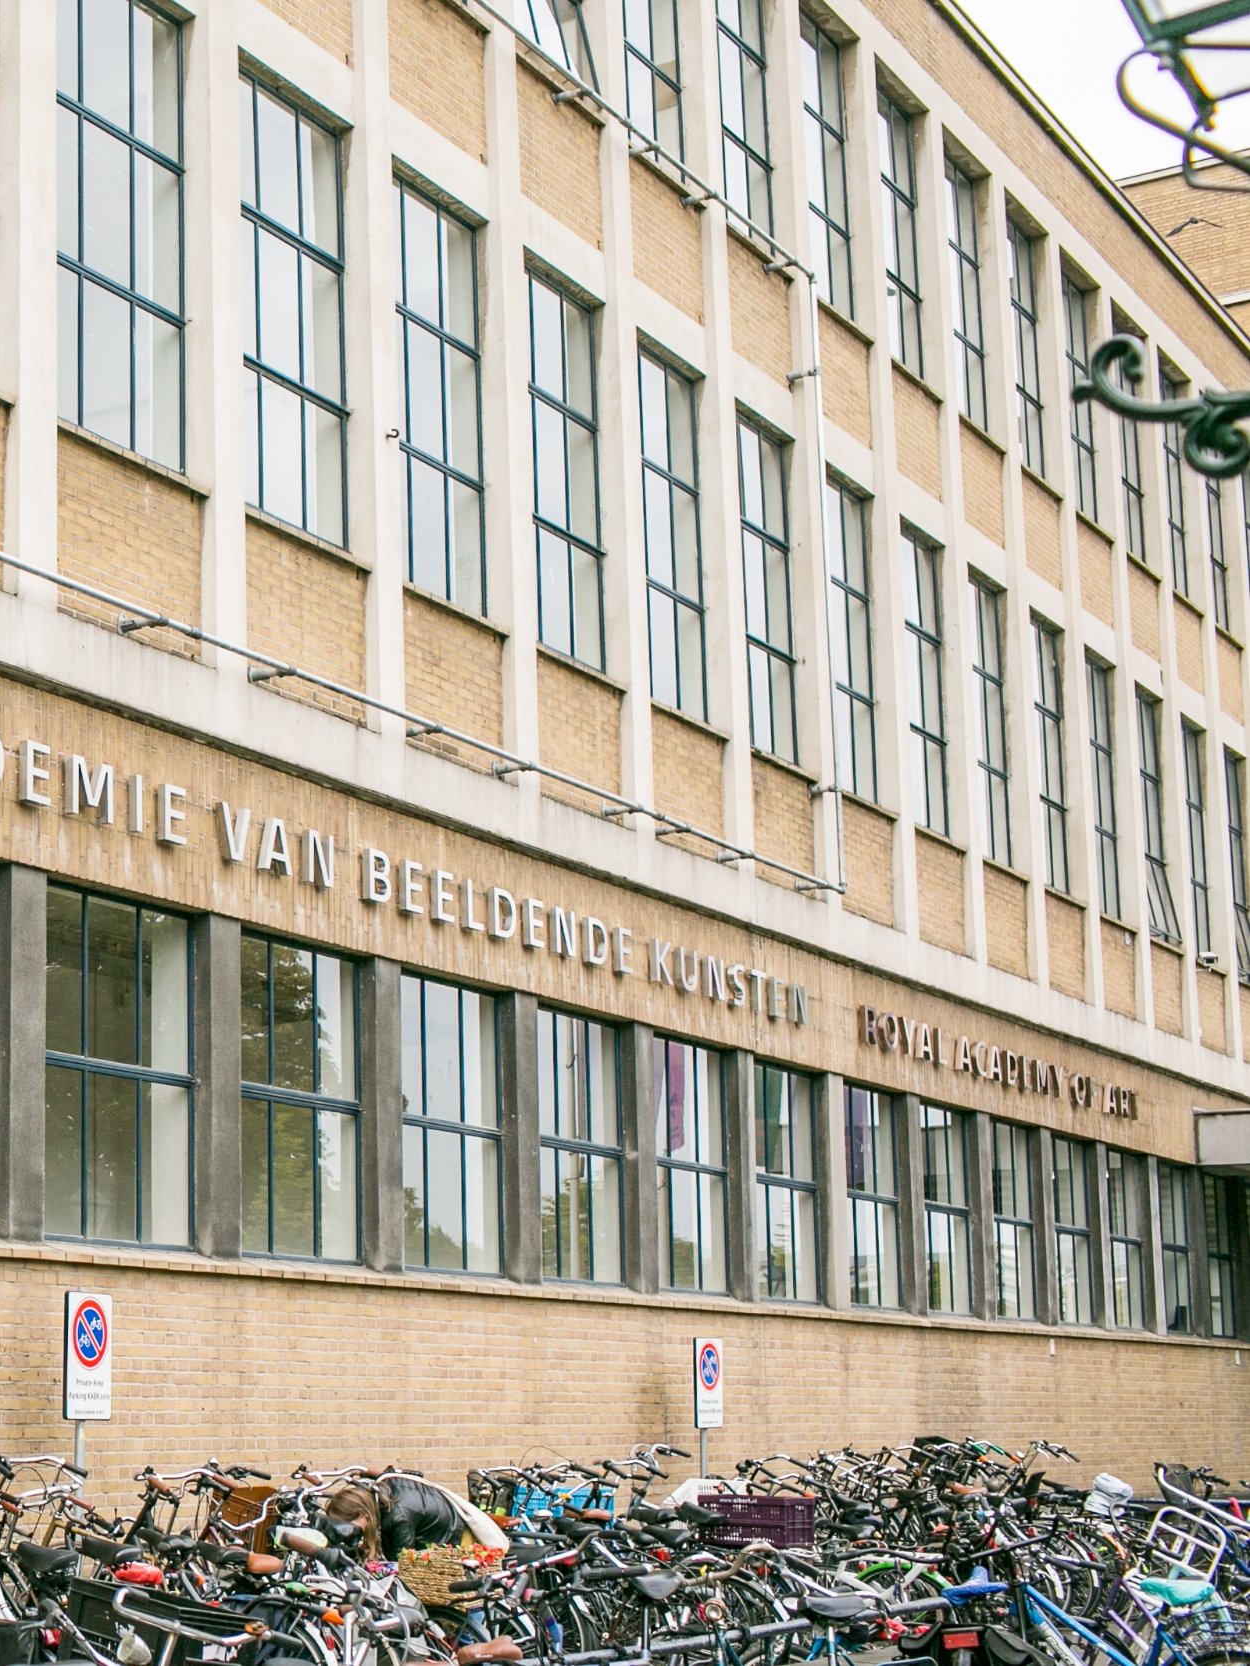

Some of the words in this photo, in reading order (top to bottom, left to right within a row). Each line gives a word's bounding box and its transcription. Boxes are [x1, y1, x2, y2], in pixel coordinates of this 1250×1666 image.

[215, 801, 335, 889] VAN
[361, 847, 635, 975] BEELDENDE
[649, 938, 809, 1025] KUNSTEN
[859, 1005, 947, 1066] ROYAL
[954, 1036, 1065, 1098] ACADEMY
[1070, 1072, 1099, 1108] OF
[1102, 1083, 1138, 1120] ART
